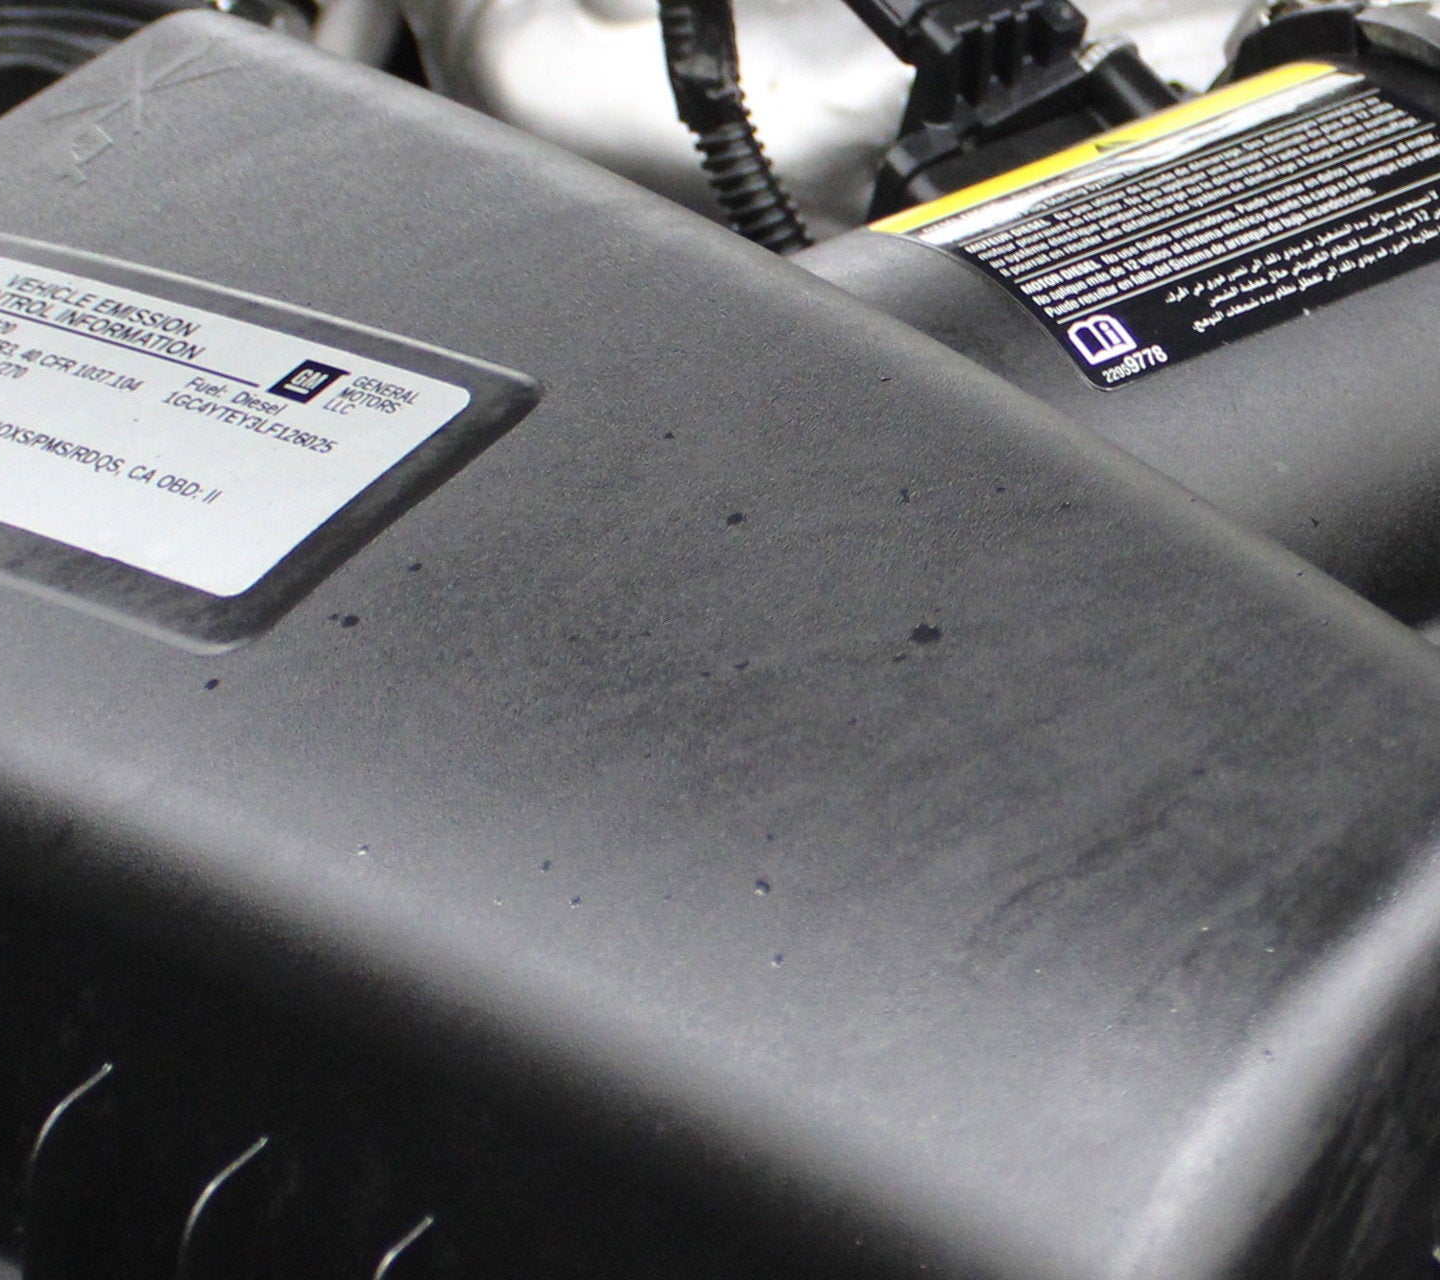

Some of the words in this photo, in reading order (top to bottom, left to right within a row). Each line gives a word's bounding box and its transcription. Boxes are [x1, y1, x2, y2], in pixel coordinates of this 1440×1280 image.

[1020, 273, 1063, 294] MOTOR
[1060, 260, 1101, 279] DIESEL
[1100, 253, 1119, 264] No
[1032, 294, 1051, 306] No
[1085, 271, 1111, 286] más
[1109, 266, 1126, 277] de
[1122, 259, 1140, 271] 12
[1044, 299, 1080, 317] Puede
[1117, 278, 1134, 290] en
[1153, 262, 1172, 276] del
[7, 275, 97, 308] VEHICLE
[93, 299, 200, 337] EMISSION
[56, 310, 204, 359] INFORMATION
[39, 354, 78, 372] CFR
[290, 369, 328, 389] GM
[1102, 345, 1167, 382] 22959778
[184, 376, 227, 398] Fuel:
[230, 391, 288, 416] Diesel
[322, 397, 356, 415] LLC
[337, 387, 401, 414] MOTORS
[352, 376, 419, 404] GENERAL
[163, 391, 336, 453] 1GC4YTEY3LF126025
[127, 465, 157, 484] CA
[156, 474, 203, 499] OBD:
